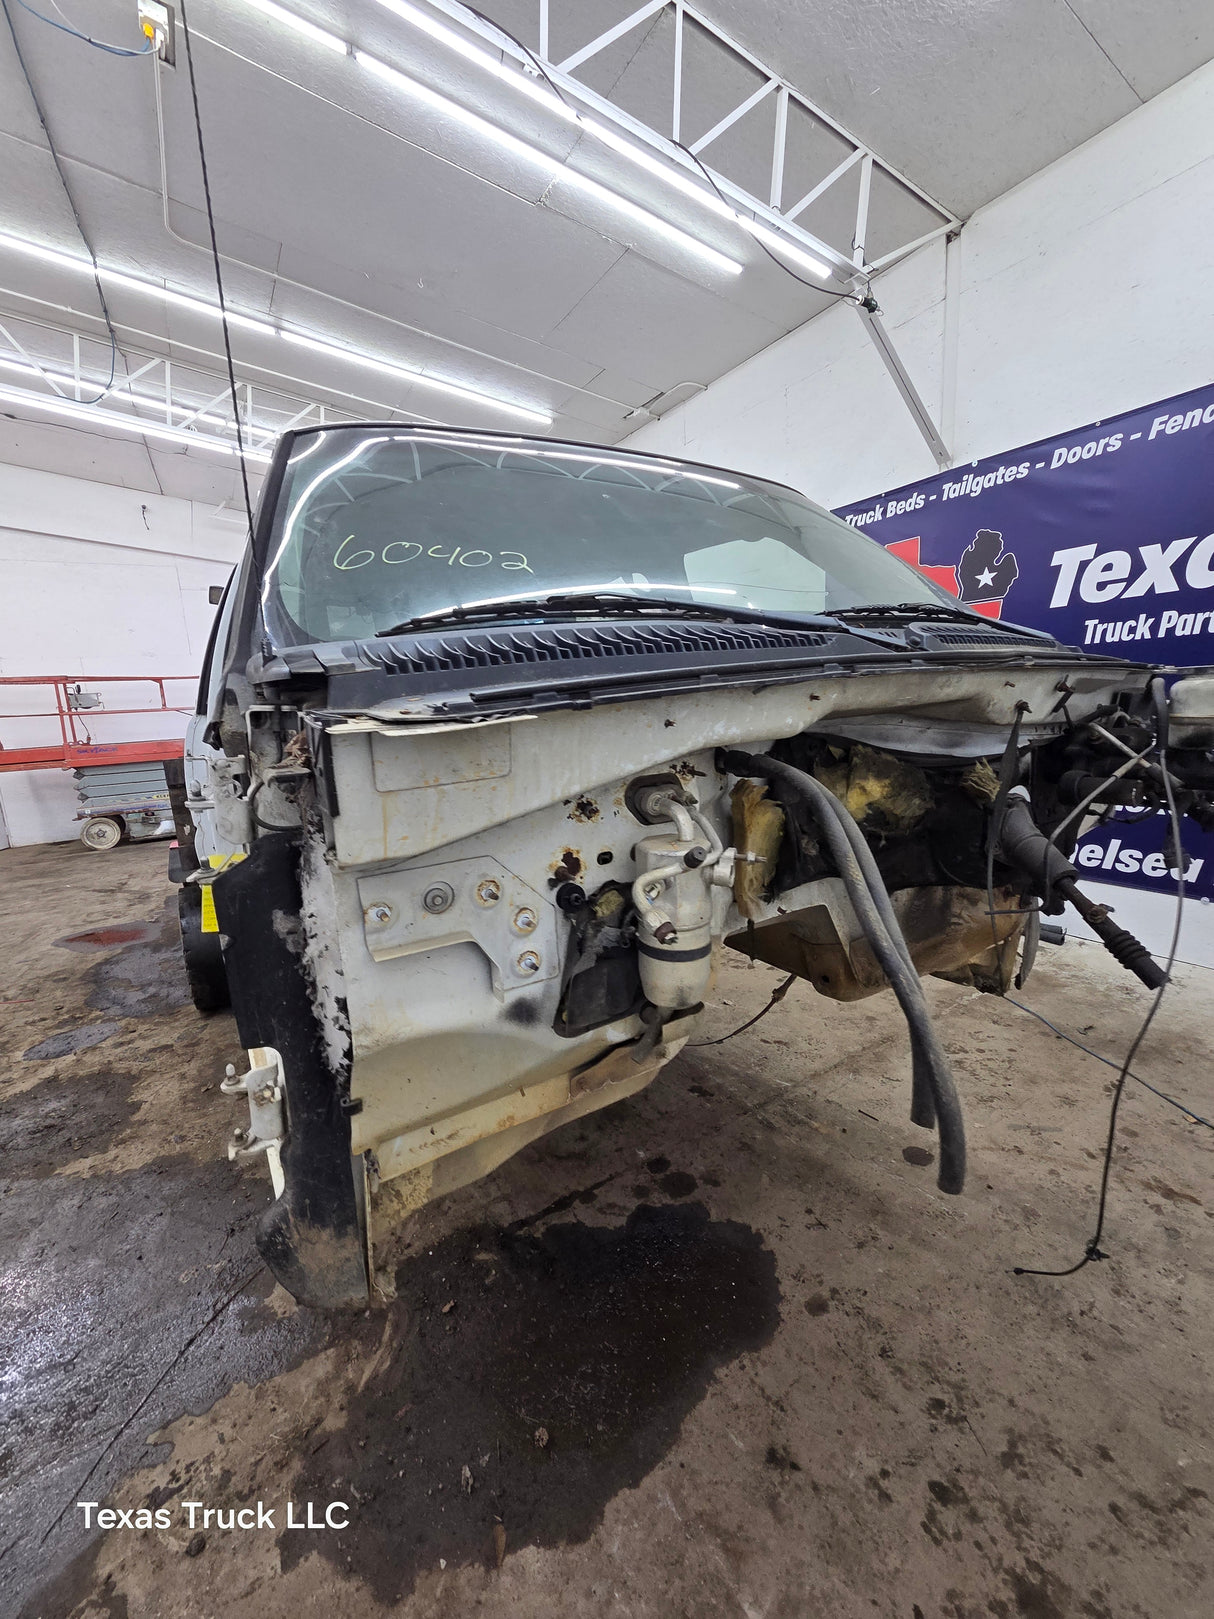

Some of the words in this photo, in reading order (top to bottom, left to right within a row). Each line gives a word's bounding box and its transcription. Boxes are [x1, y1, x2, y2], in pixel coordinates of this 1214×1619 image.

[845, 504, 884, 528] Truck
[886, 492, 926, 518] Beds
[942, 462, 1030, 502] Tailgates
[1035, 461, 1046, 470] -
[1050, 433, 1124, 470] Doors
[1129, 432, 1143, 441] -
[333, 534, 536, 577] 60402
[1084, 613, 1156, 645] Truck
[1068, 838, 1205, 883] elsea
